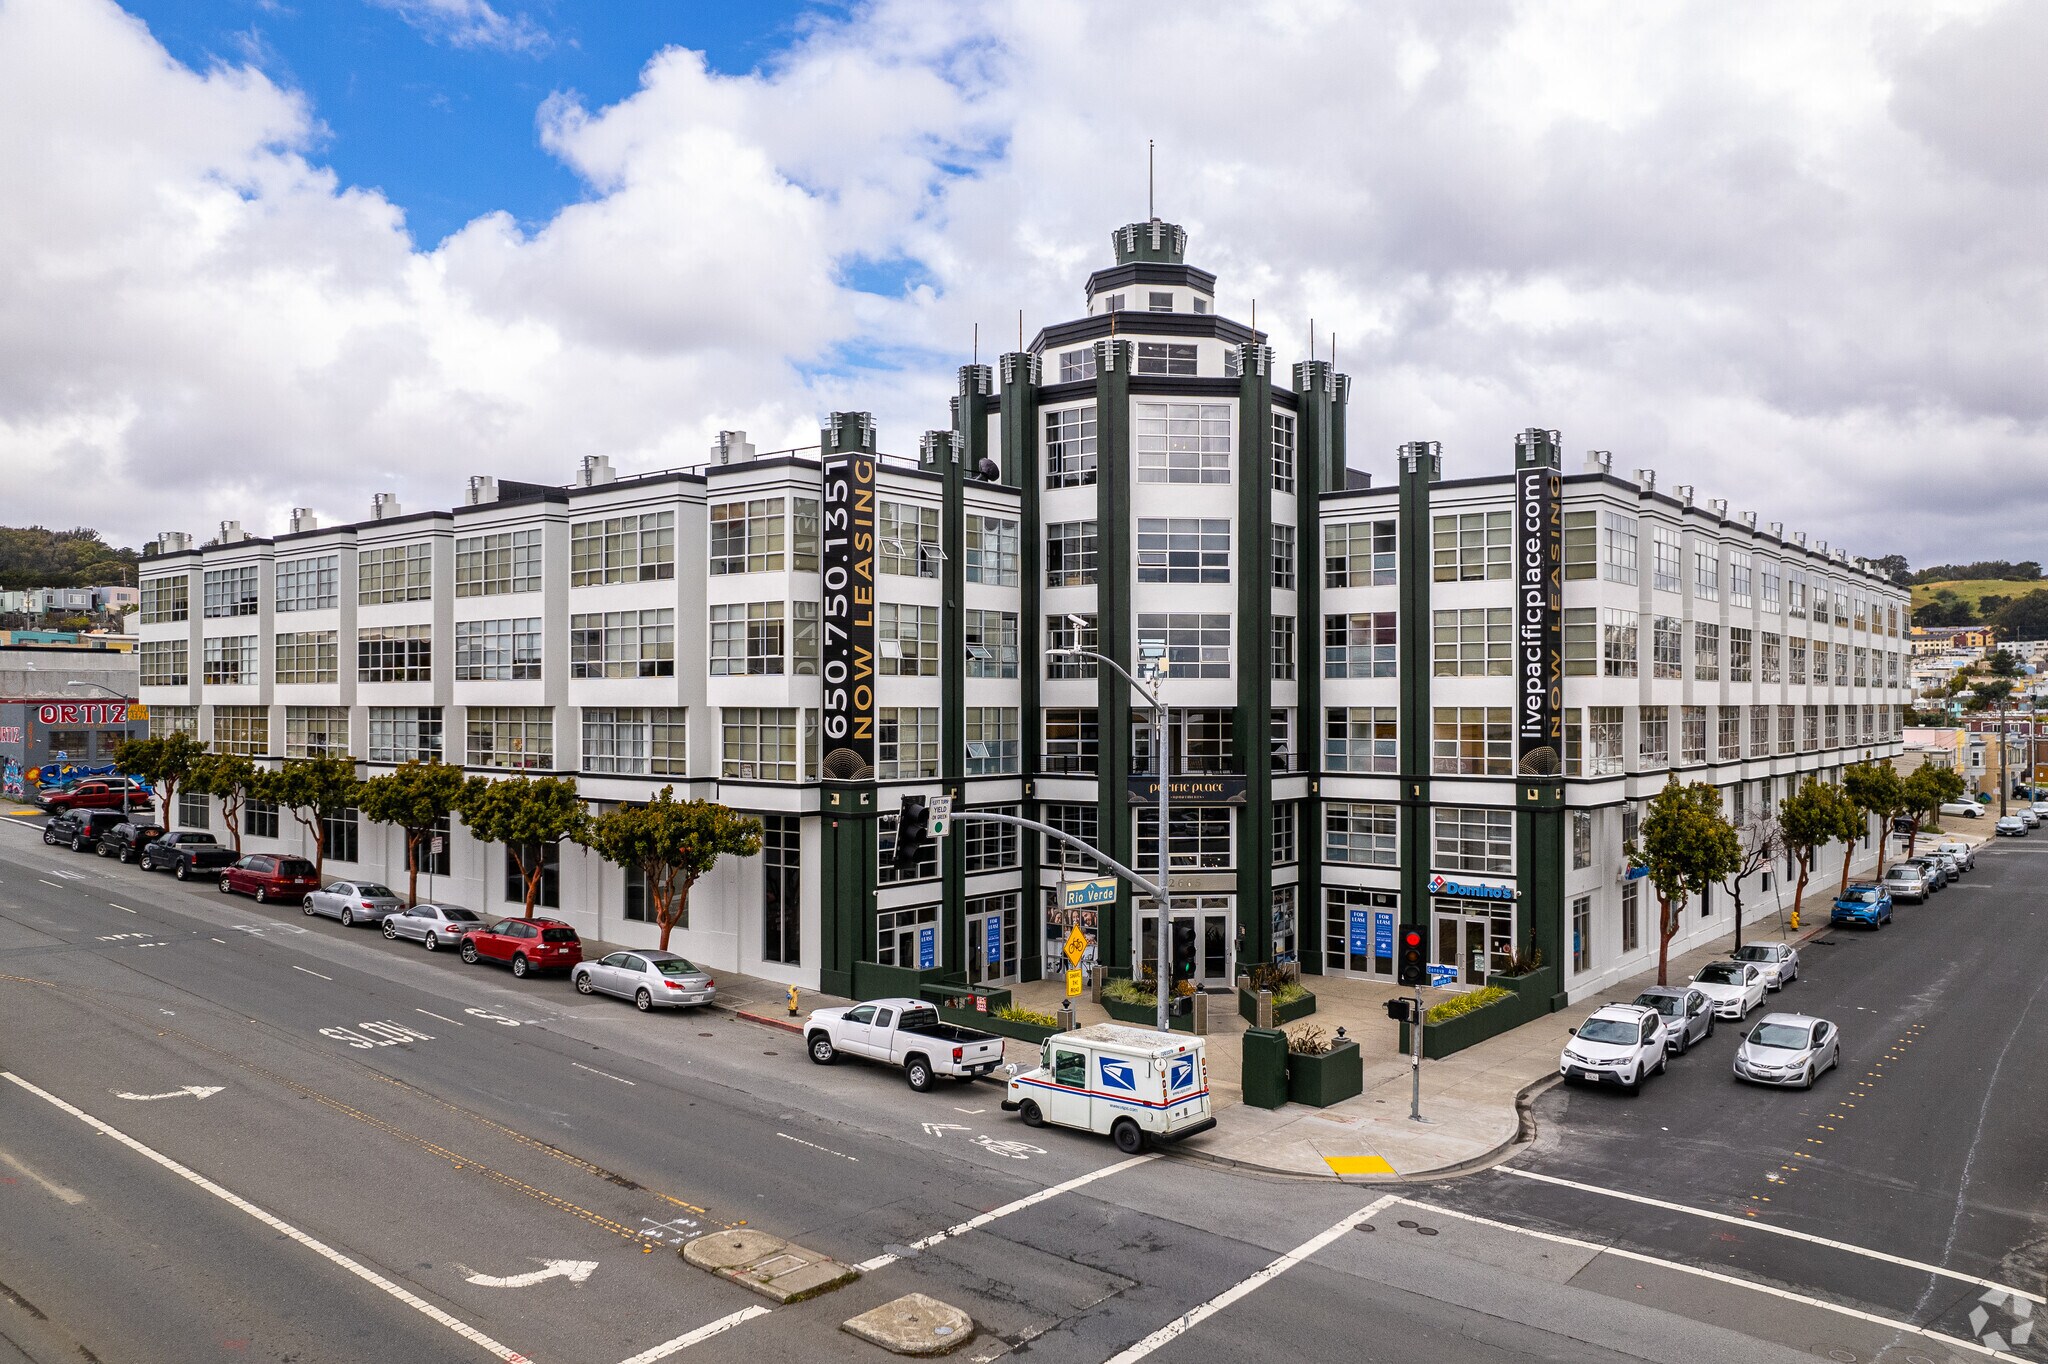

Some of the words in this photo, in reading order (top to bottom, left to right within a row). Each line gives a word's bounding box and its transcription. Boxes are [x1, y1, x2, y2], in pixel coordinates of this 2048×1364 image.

[854, 460, 873, 627] LEASING
[1551, 476, 1560, 632] LEASING
[825, 460, 848, 739] 650.750.1351
[1521, 475, 1546, 737] livepacificplace.com
[39, 704, 129, 724] ORTIZ
[128, 704, 147, 712] AUTO
[854, 645, 873, 739] NOW
[1551, 650, 1561, 737] NOW
[0, 726, 20, 743] RTIZ
[1068, 892, 1083, 904] Rio
[1087, 889, 1113, 901] Verde
[1446, 881, 1512, 899] Domino's
[318, 1020, 437, 1049] SLOW
